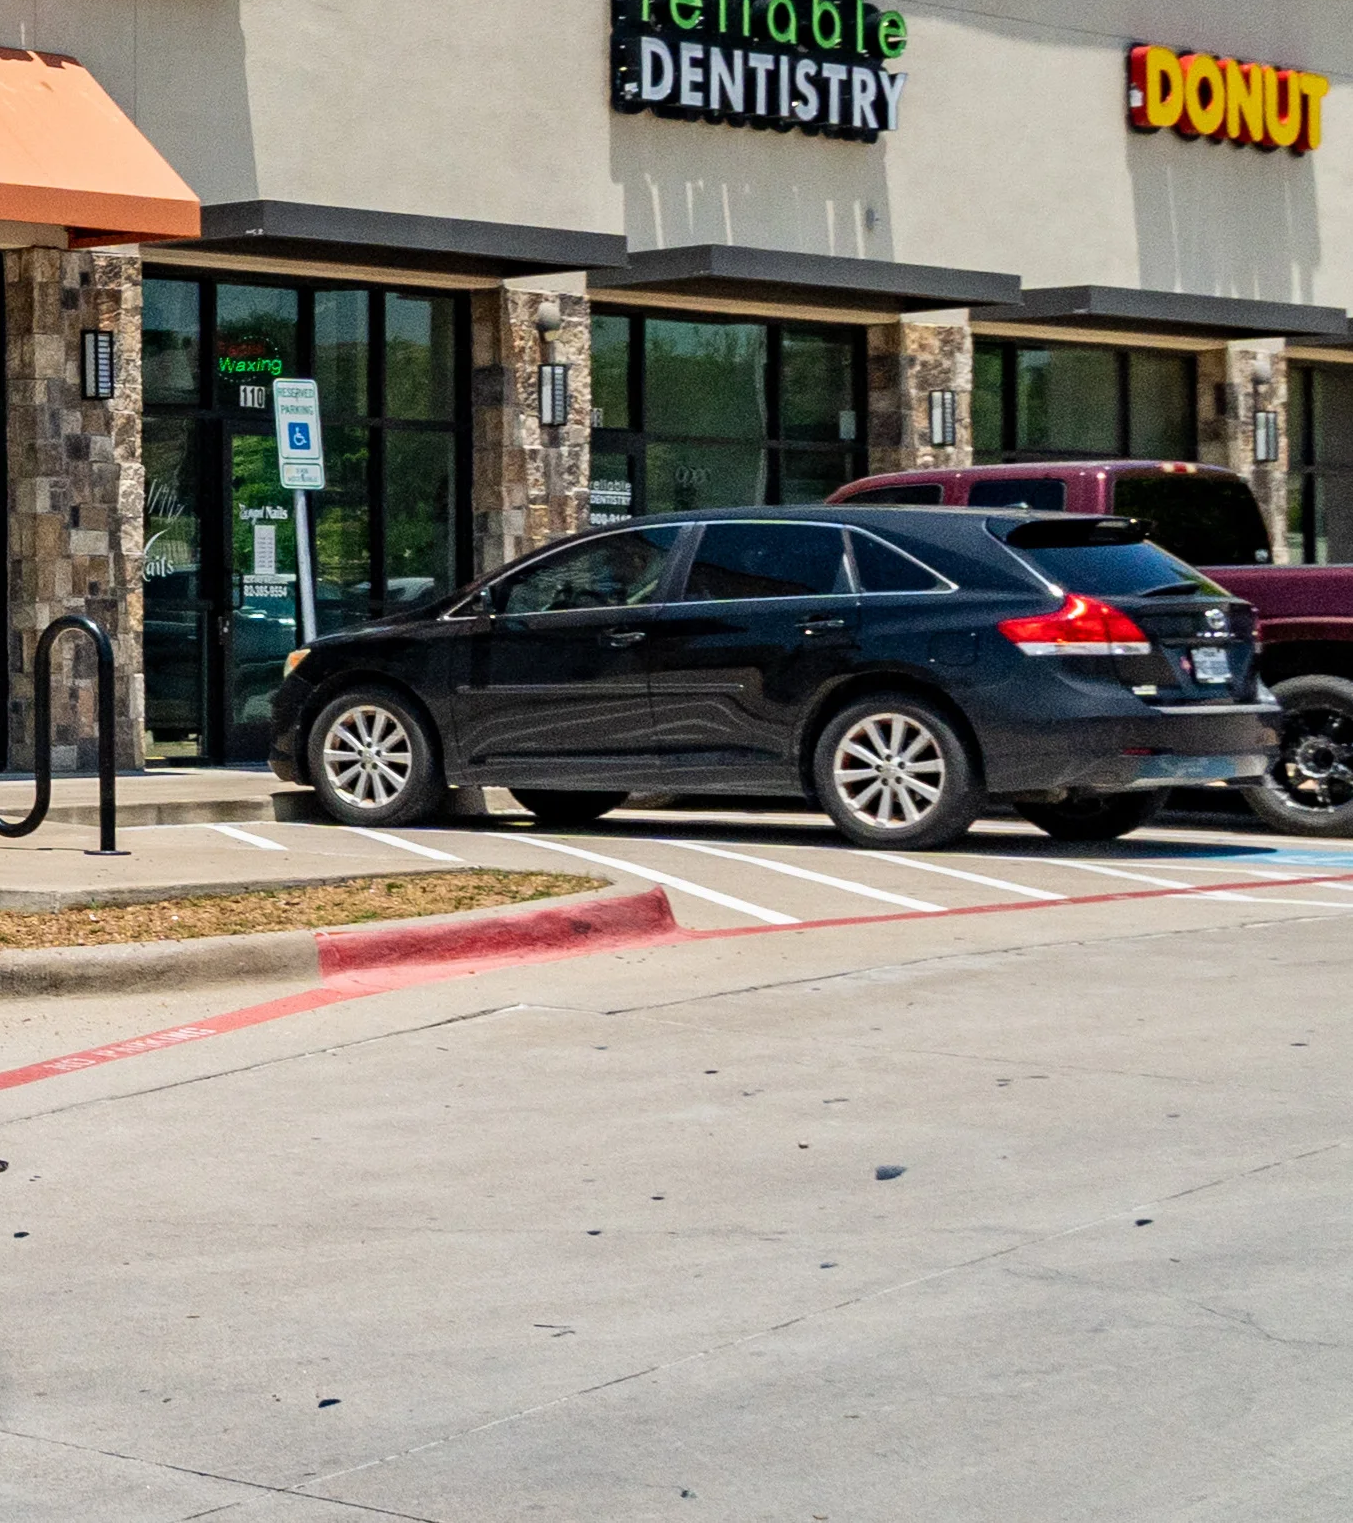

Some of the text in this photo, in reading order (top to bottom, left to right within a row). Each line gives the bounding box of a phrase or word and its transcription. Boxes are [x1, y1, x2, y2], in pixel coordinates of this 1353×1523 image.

[640, 36, 908, 132] DENTISTRY
[1145, 45, 1331, 151] DONUT
[219, 357, 283, 376] Waxing
[241, 386, 265, 407] 110
[277, 387, 315, 399] RESERVED
[281, 405, 314, 416] PARKING
[266, 506, 288, 519] Nails
